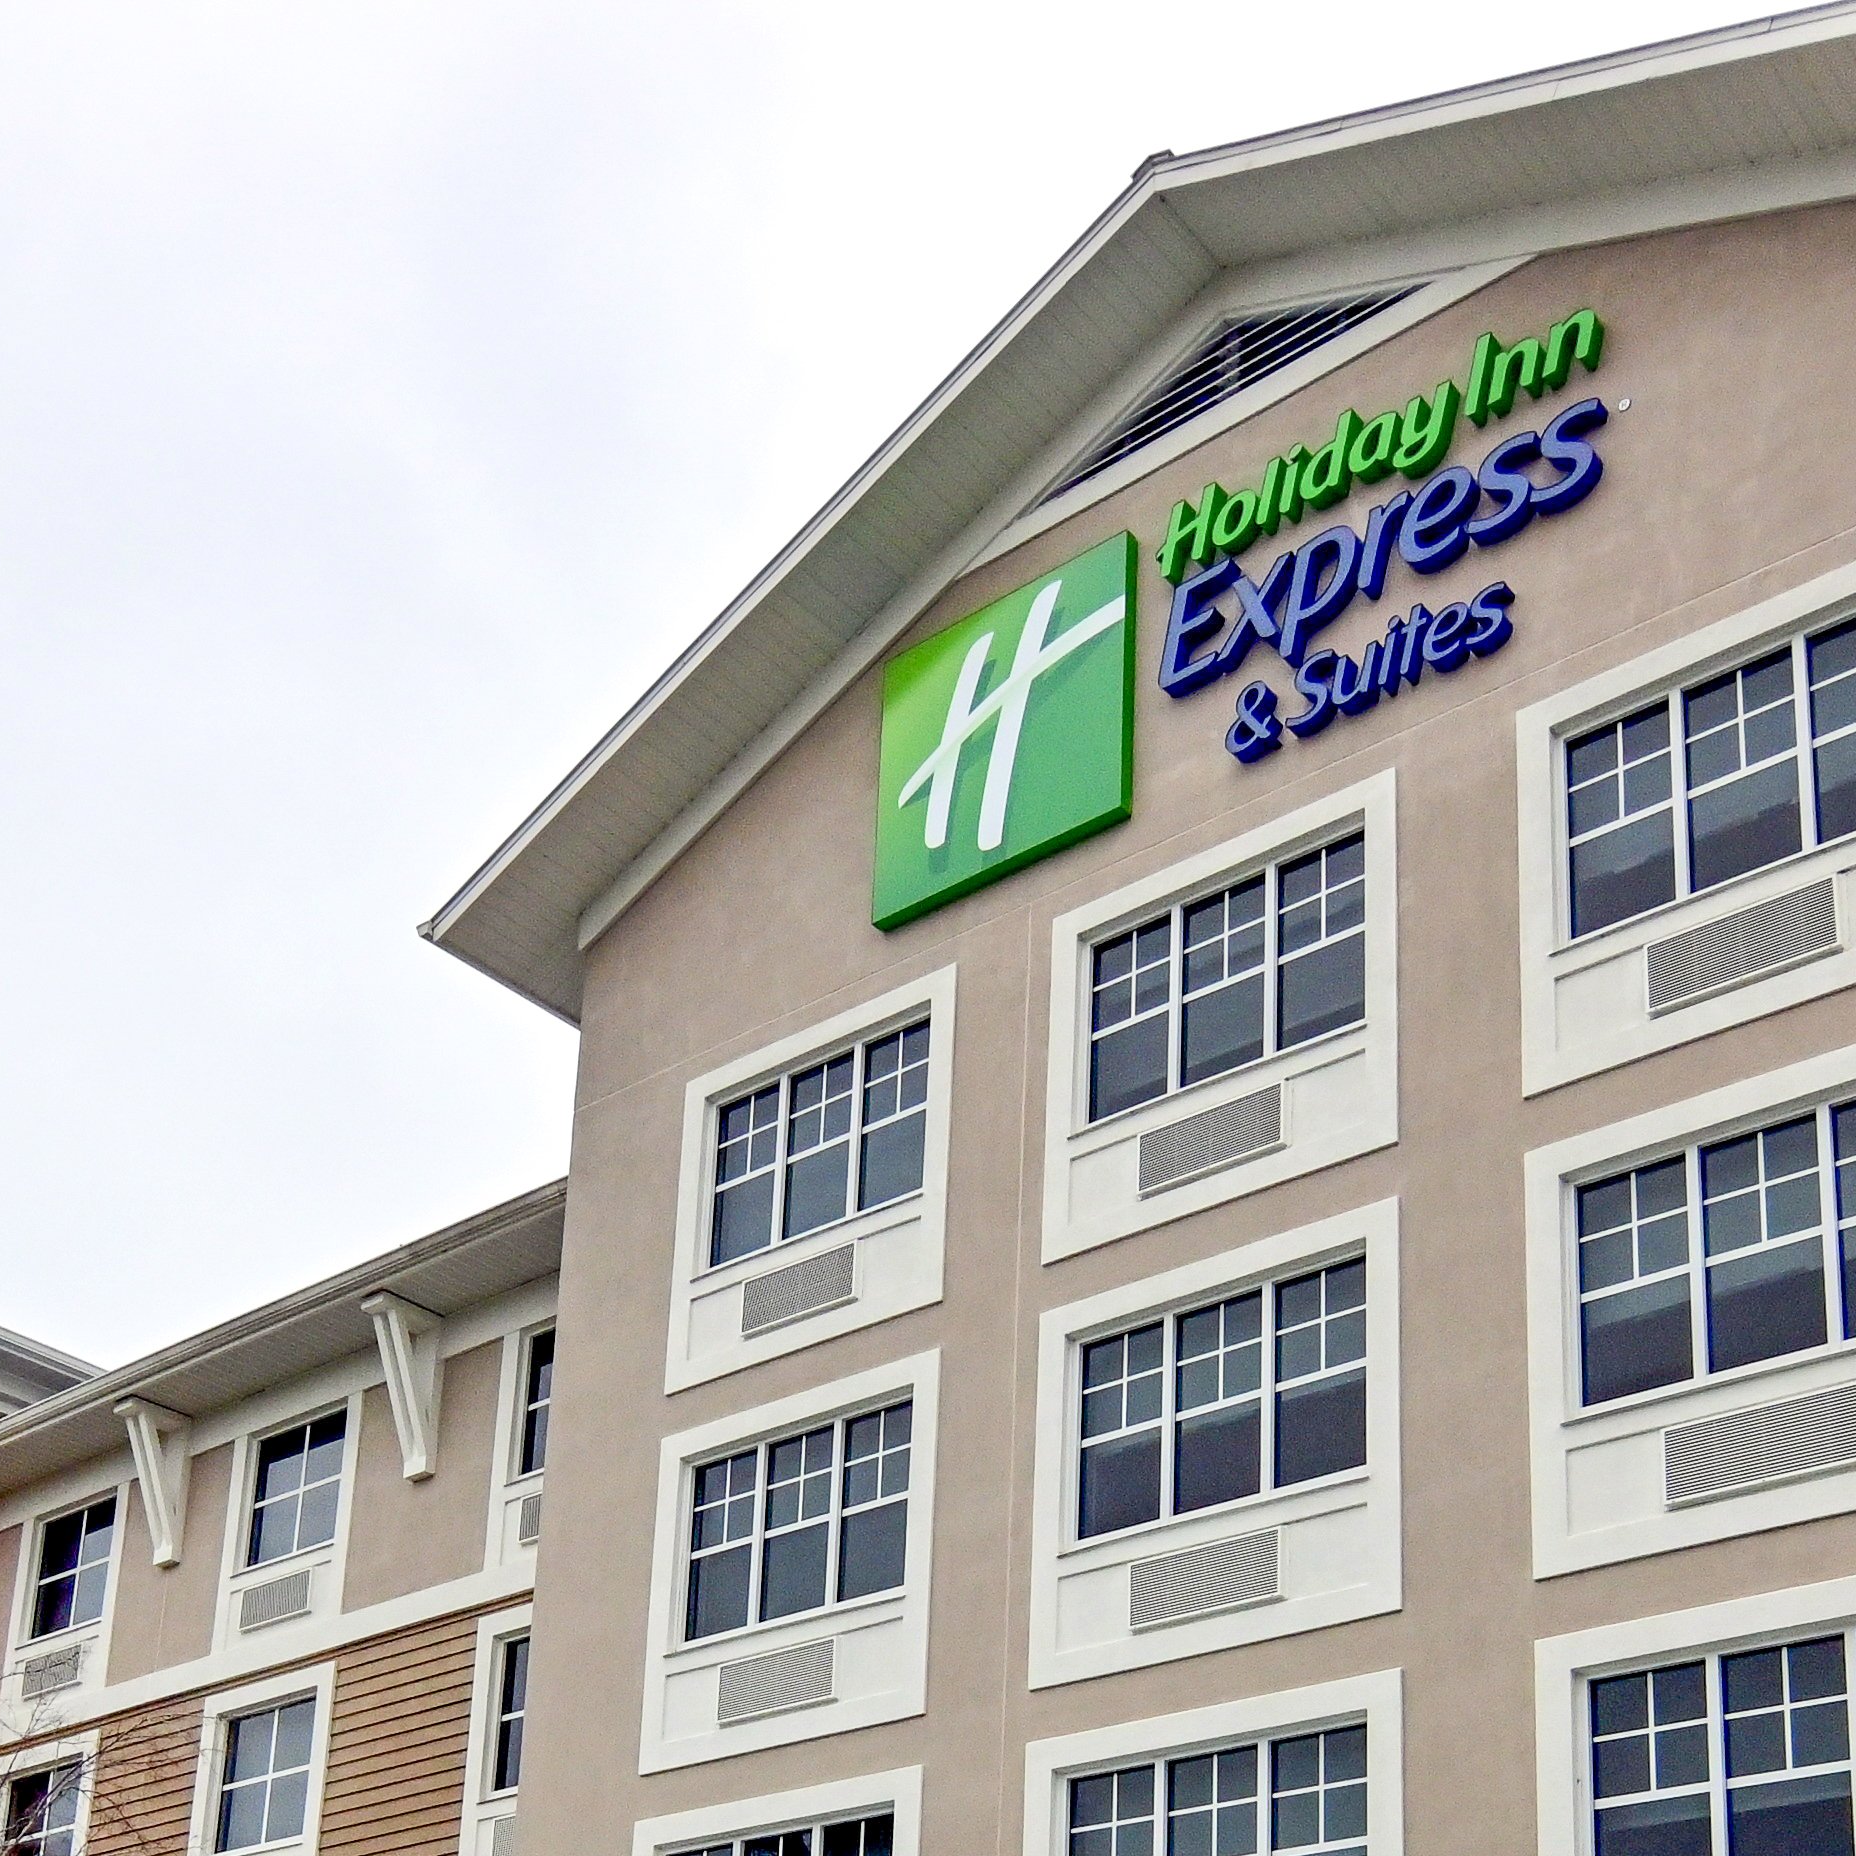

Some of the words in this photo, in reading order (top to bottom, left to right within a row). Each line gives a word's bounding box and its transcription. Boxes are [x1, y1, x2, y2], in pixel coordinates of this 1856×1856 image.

[1155, 379, 1462, 584] Holiday
[1463, 308, 1605, 426] Inn
[1157, 396, 1610, 698] Express
[1224, 680, 1283, 763] &
[1285, 581, 1517, 737] Suites
